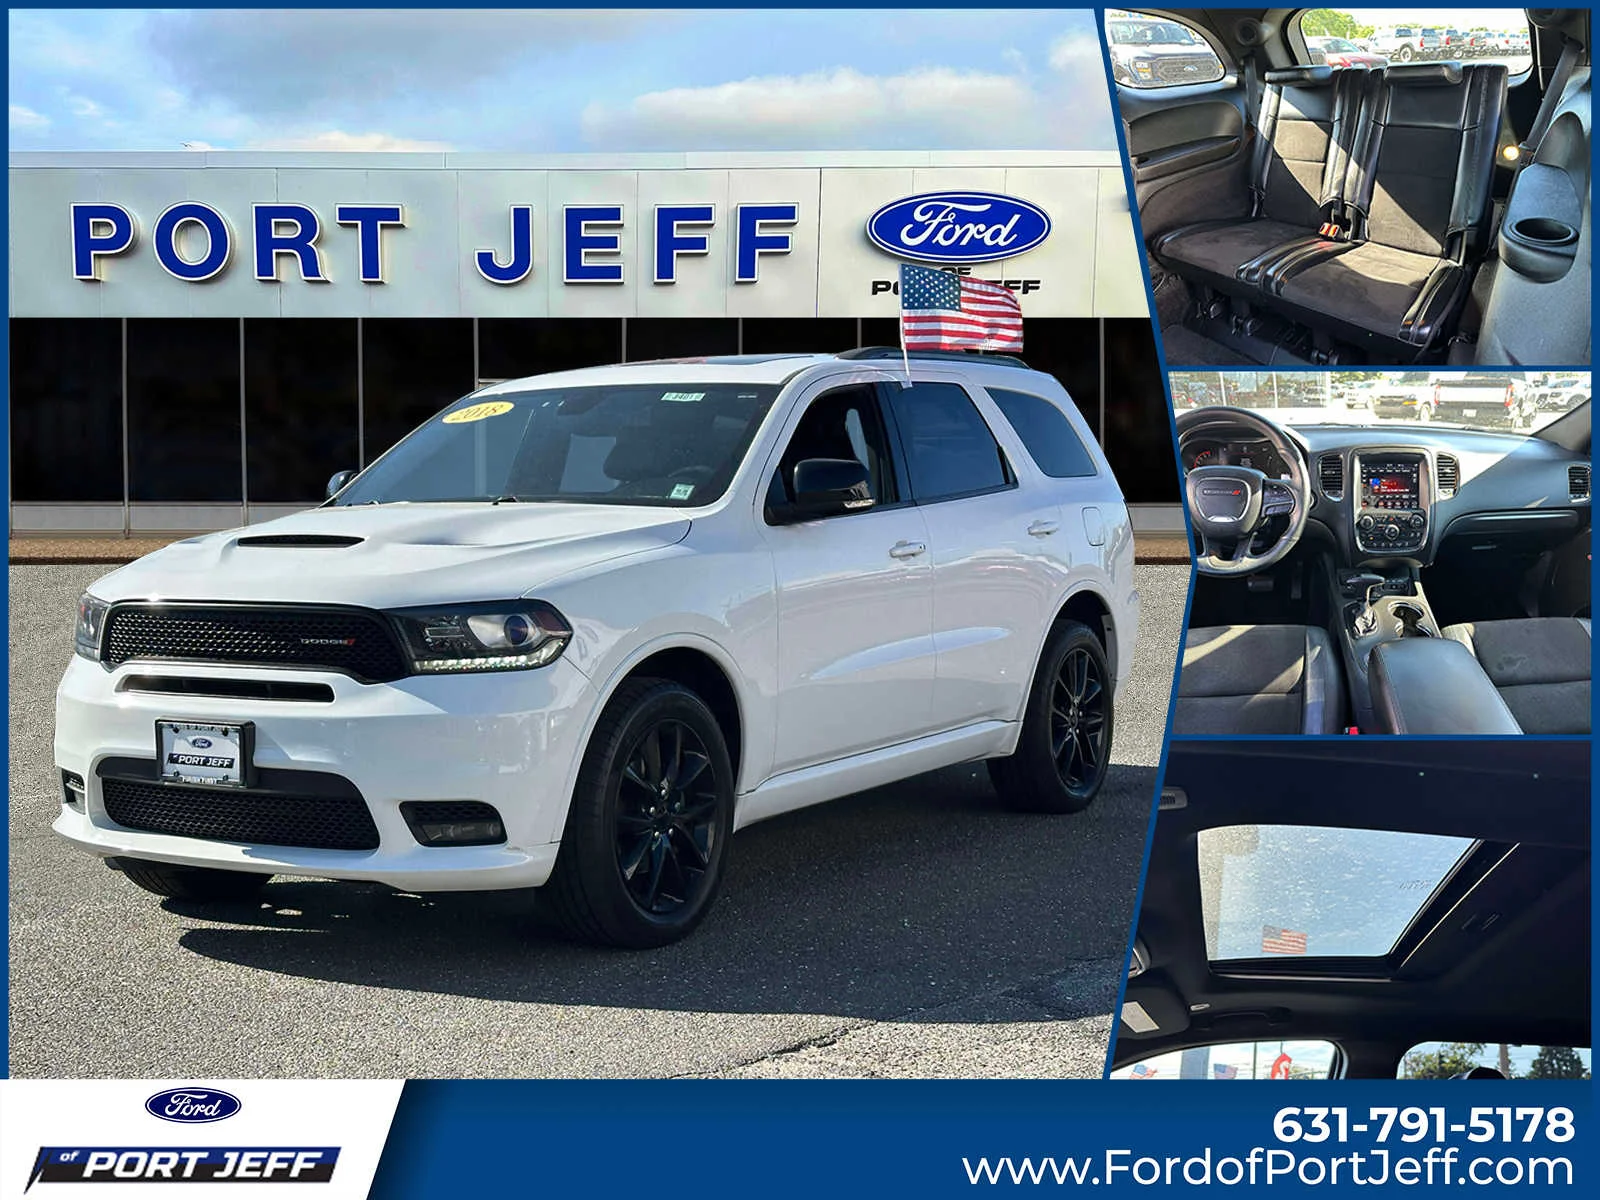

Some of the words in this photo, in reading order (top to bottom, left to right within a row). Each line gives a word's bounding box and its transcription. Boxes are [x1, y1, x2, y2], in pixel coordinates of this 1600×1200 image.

[71, 201, 404, 282] PORT
[475, 202, 799, 284] JEFF
[900, 201, 1021, 247] Ford
[178, 755, 206, 766] PORT
[206, 757, 232, 768] JEFF
